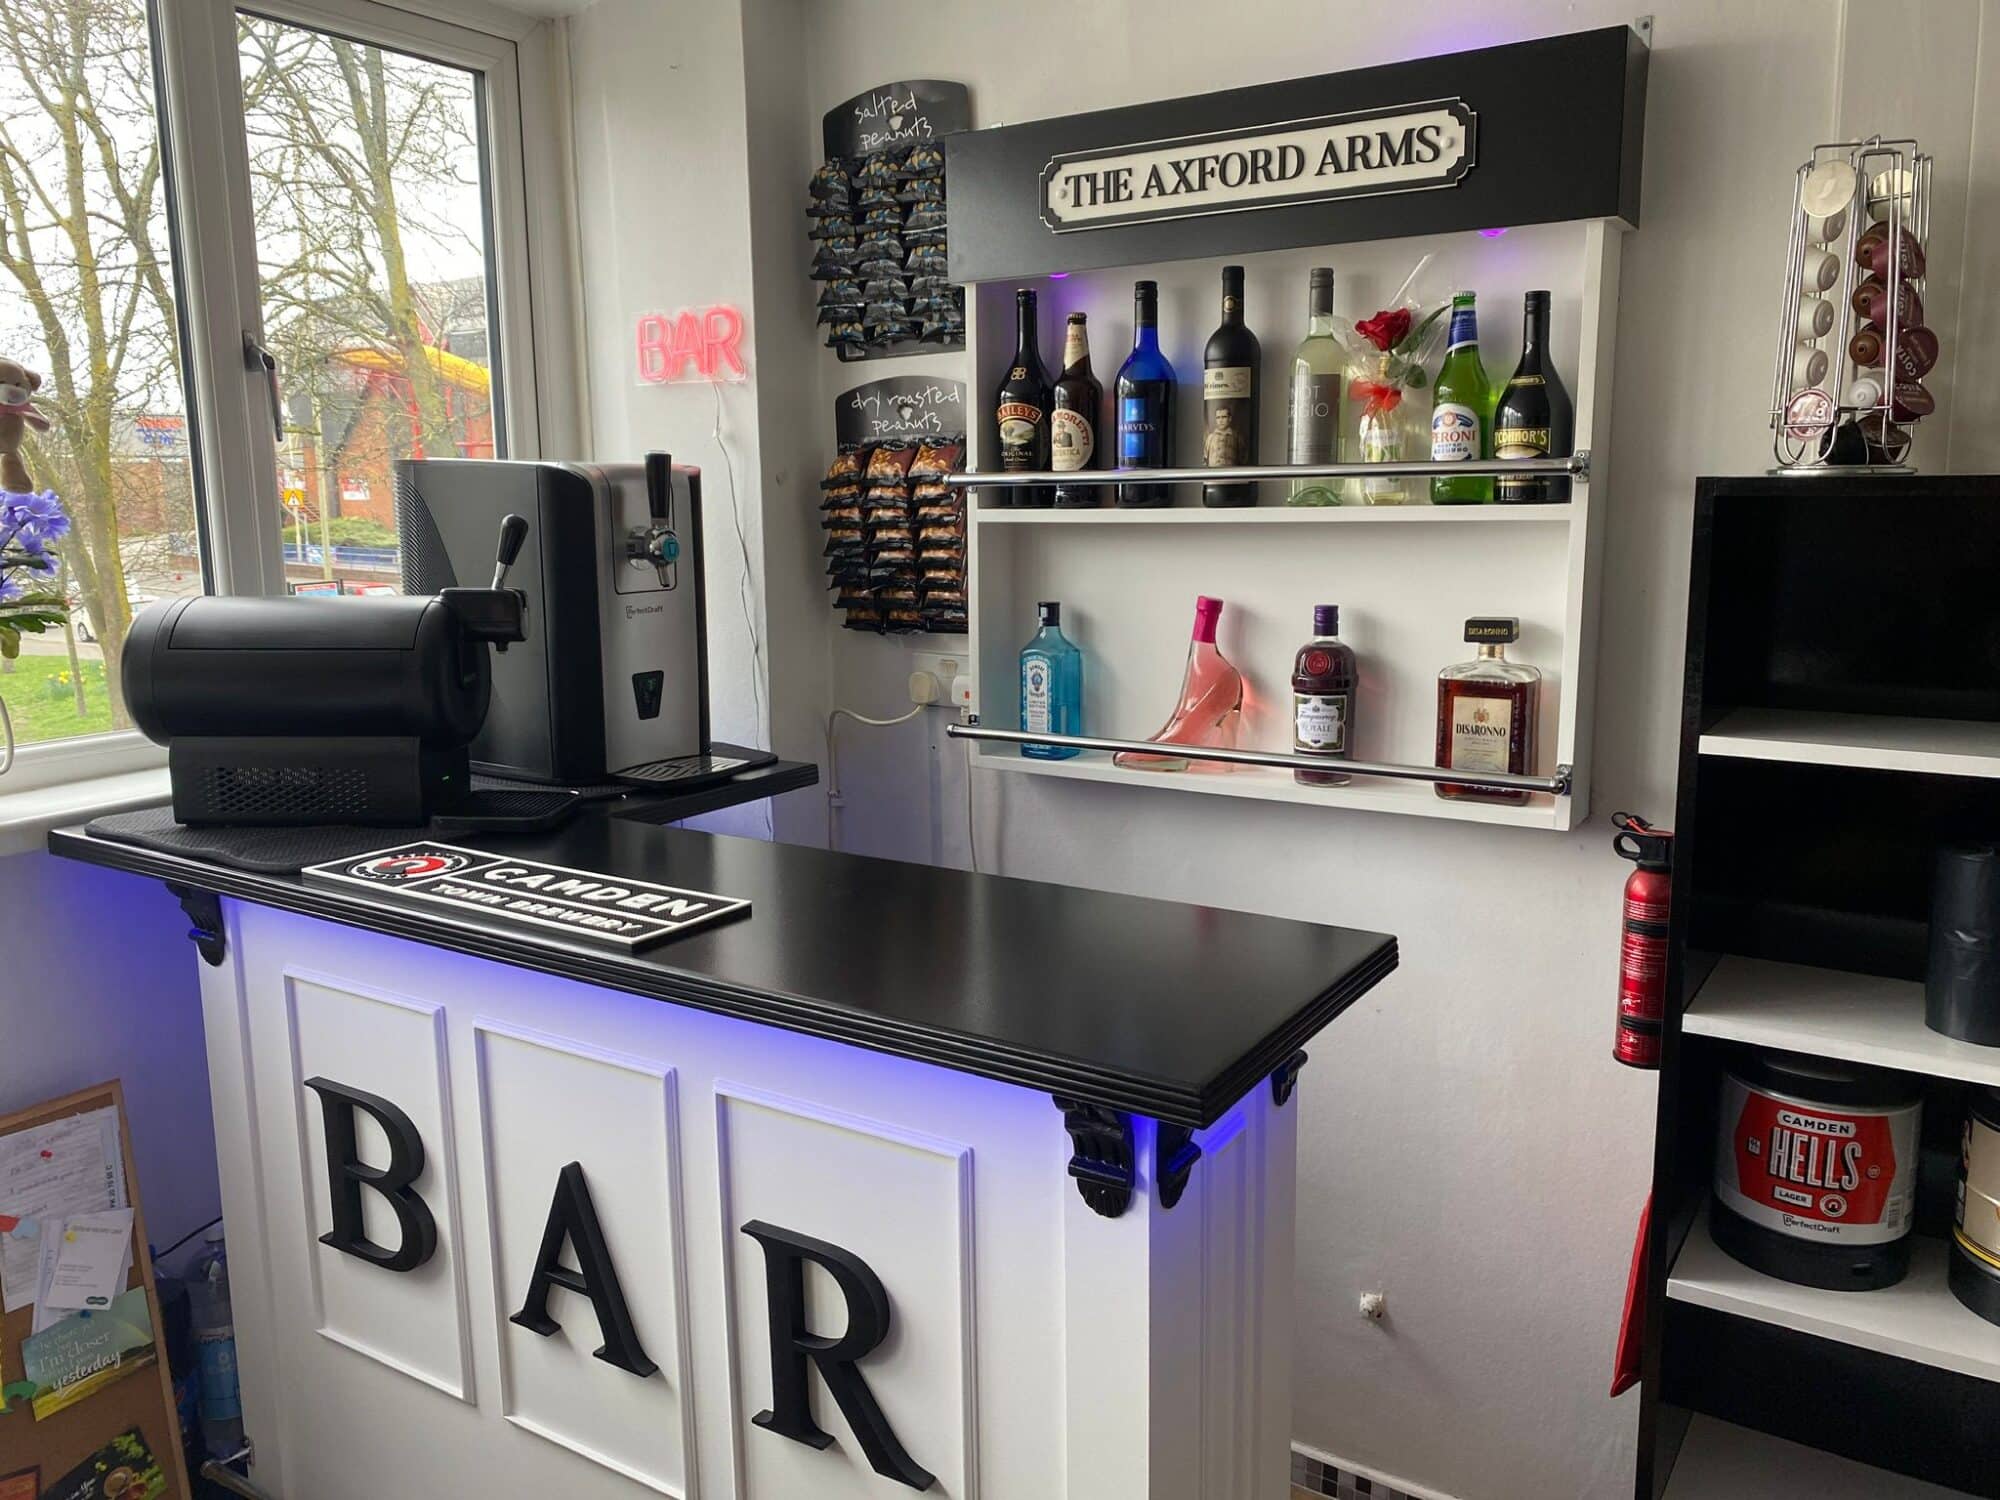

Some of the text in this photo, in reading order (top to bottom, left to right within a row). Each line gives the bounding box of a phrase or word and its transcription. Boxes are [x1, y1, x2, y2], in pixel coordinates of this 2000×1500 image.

[854, 90, 918, 125] salted
[860, 116, 933, 150] peanuts
[1065, 125, 1442, 208] THE AXFORD ARMS
[636, 306, 746, 383] BAR
[851, 384, 961, 417] dry roasted
[872, 411, 943, 438] peanuts
[1432, 430, 1477, 443] PERONI
[1456, 722, 1507, 738] DISARONNO
[431, 884, 644, 932] TOWN BREWERY
[484, 867, 709, 917] CAMDEN
[1782, 1114, 1851, 1135] CAMDEN
[1769, 1127, 1862, 1191] HELLS
[1779, 1189, 1808, 1203] LAGER
[1783, 1213, 1841, 1234] PerfectDraft
[52, 1351, 121, 1398] yesterday
